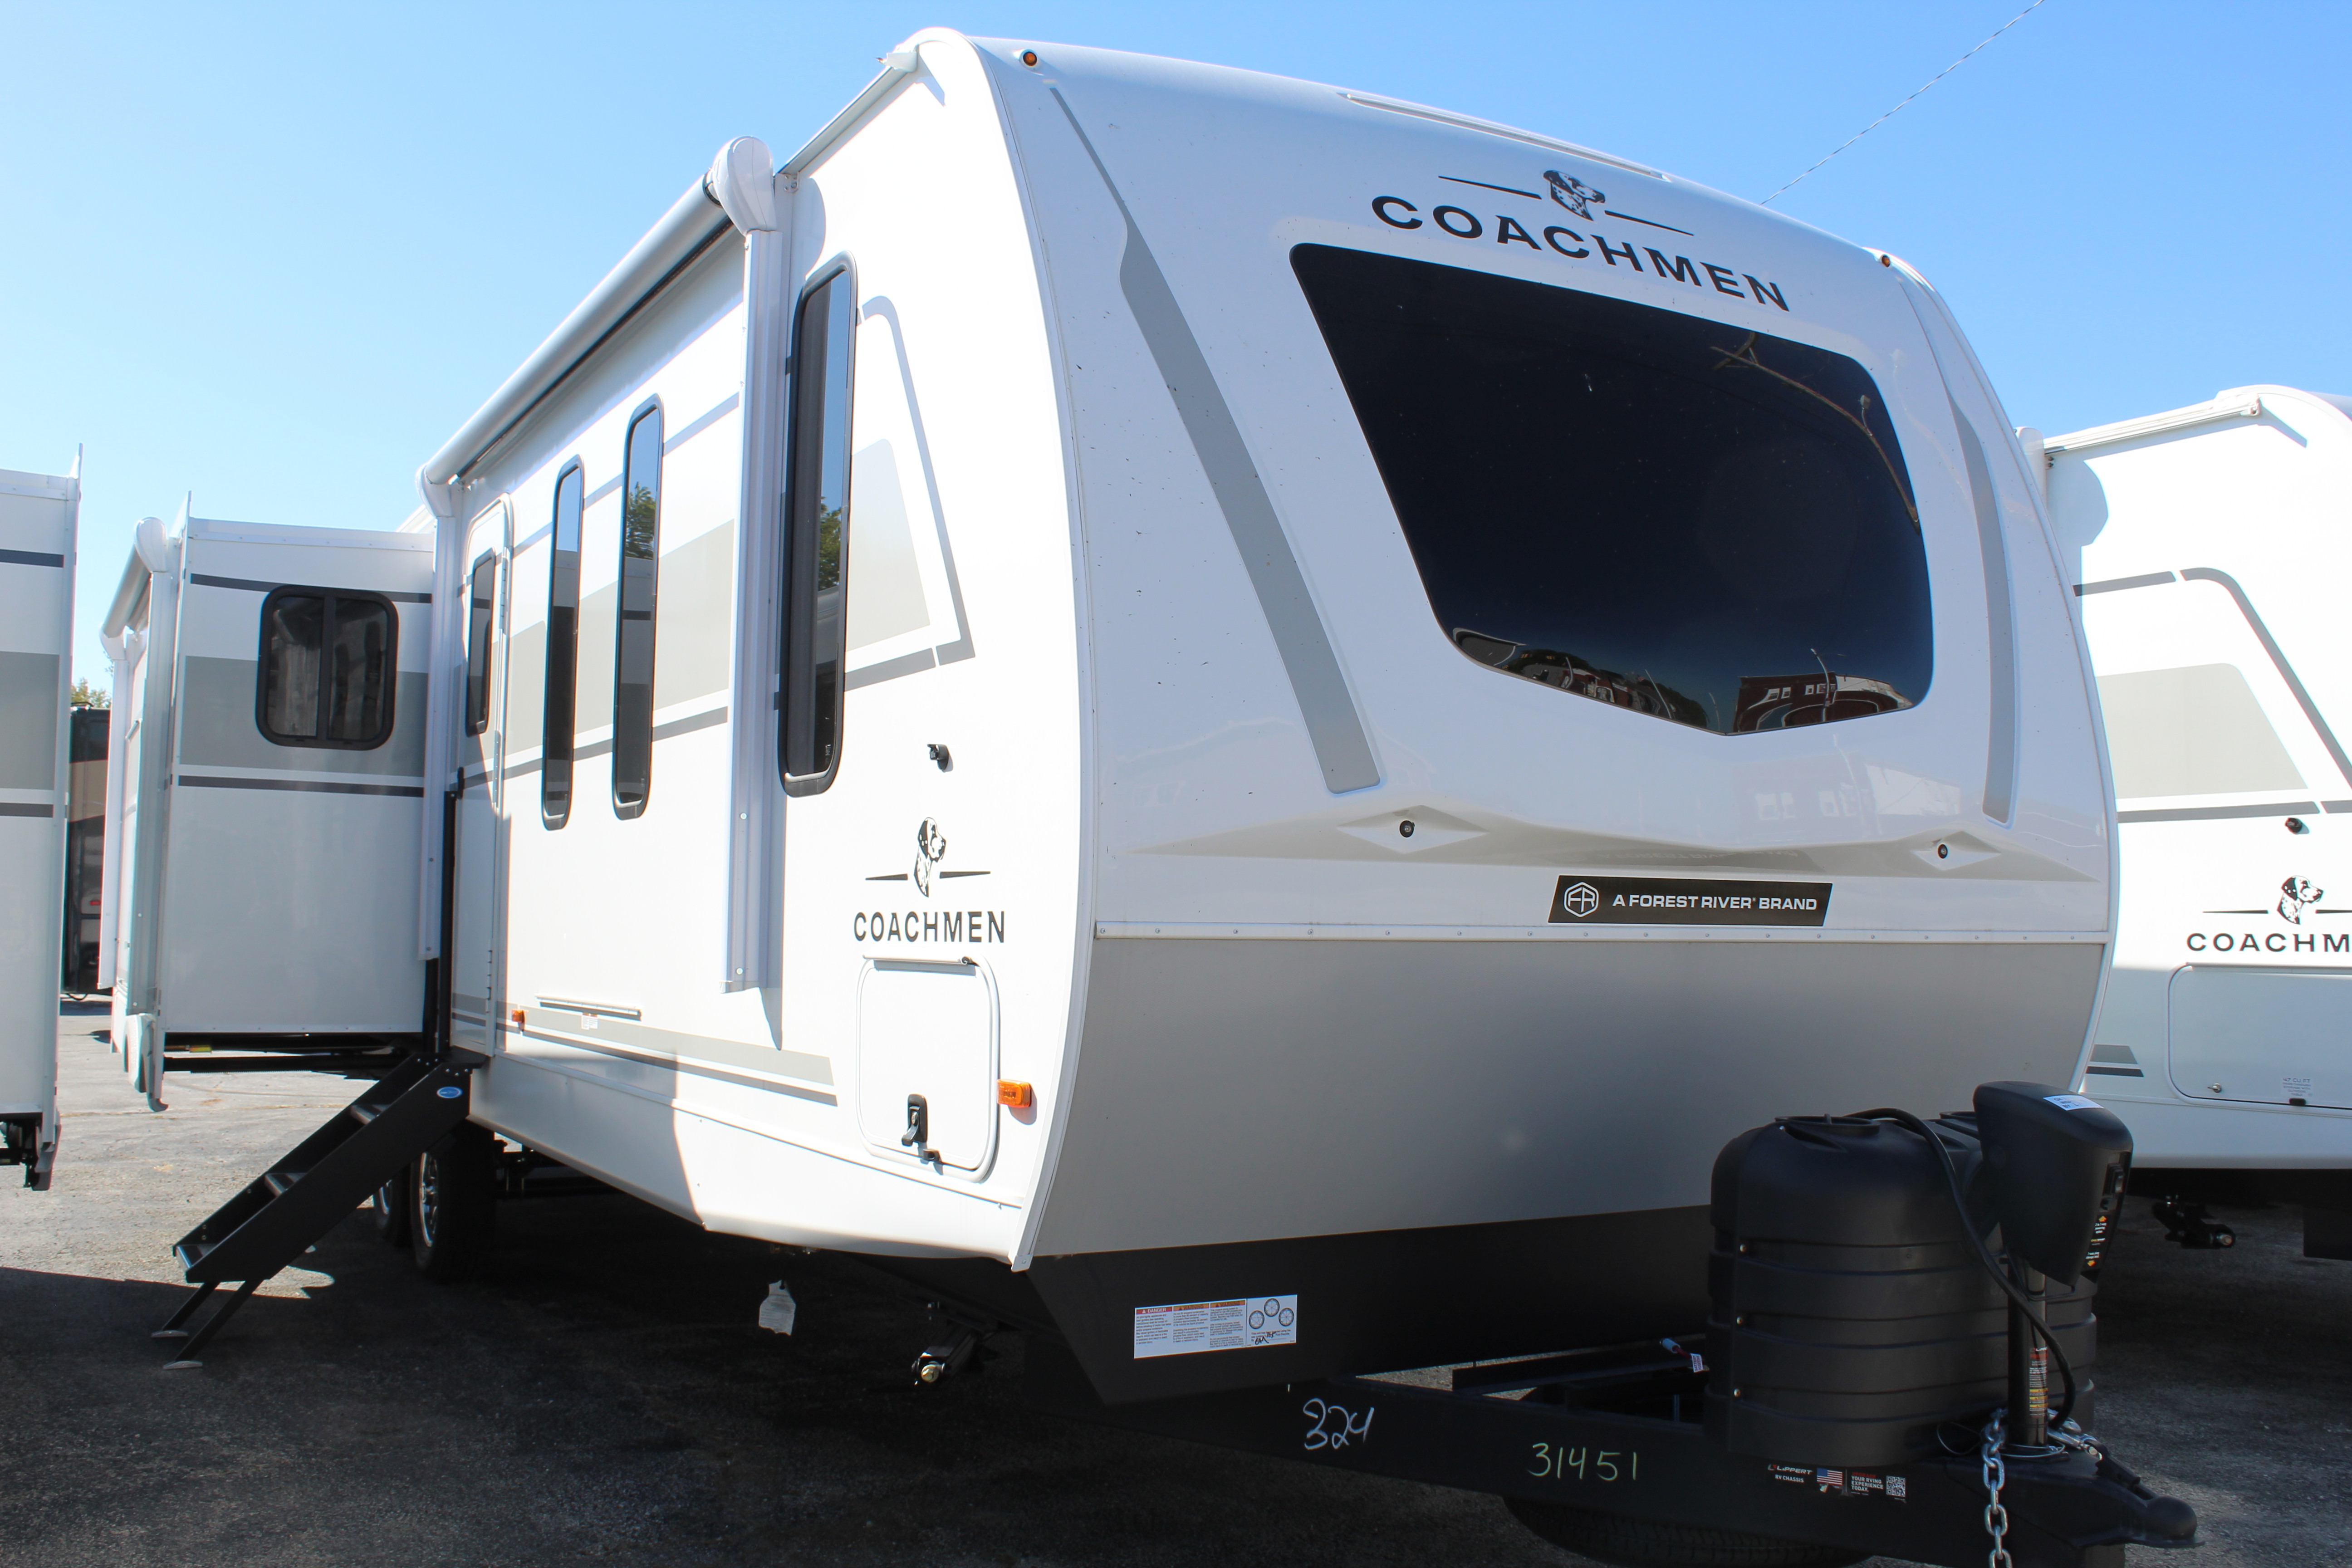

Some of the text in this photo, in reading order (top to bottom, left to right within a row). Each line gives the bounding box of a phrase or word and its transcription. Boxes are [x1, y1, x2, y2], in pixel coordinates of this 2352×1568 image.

[1372, 196, 1790, 313] COACHMEN
[1612, 894, 1626, 907] A
[1629, 894, 1698, 908] FOREST
[1758, 898, 1817, 910] BRAND
[853, 910, 1005, 943] COACHMEN
[2186, 933, 2350, 952] COACHM
[1528, 1443, 1637, 1481] 31451
[1777, 1466, 1812, 1475] LIPPERT
[1851, 1480, 1884, 1490] EXPERIENCE
